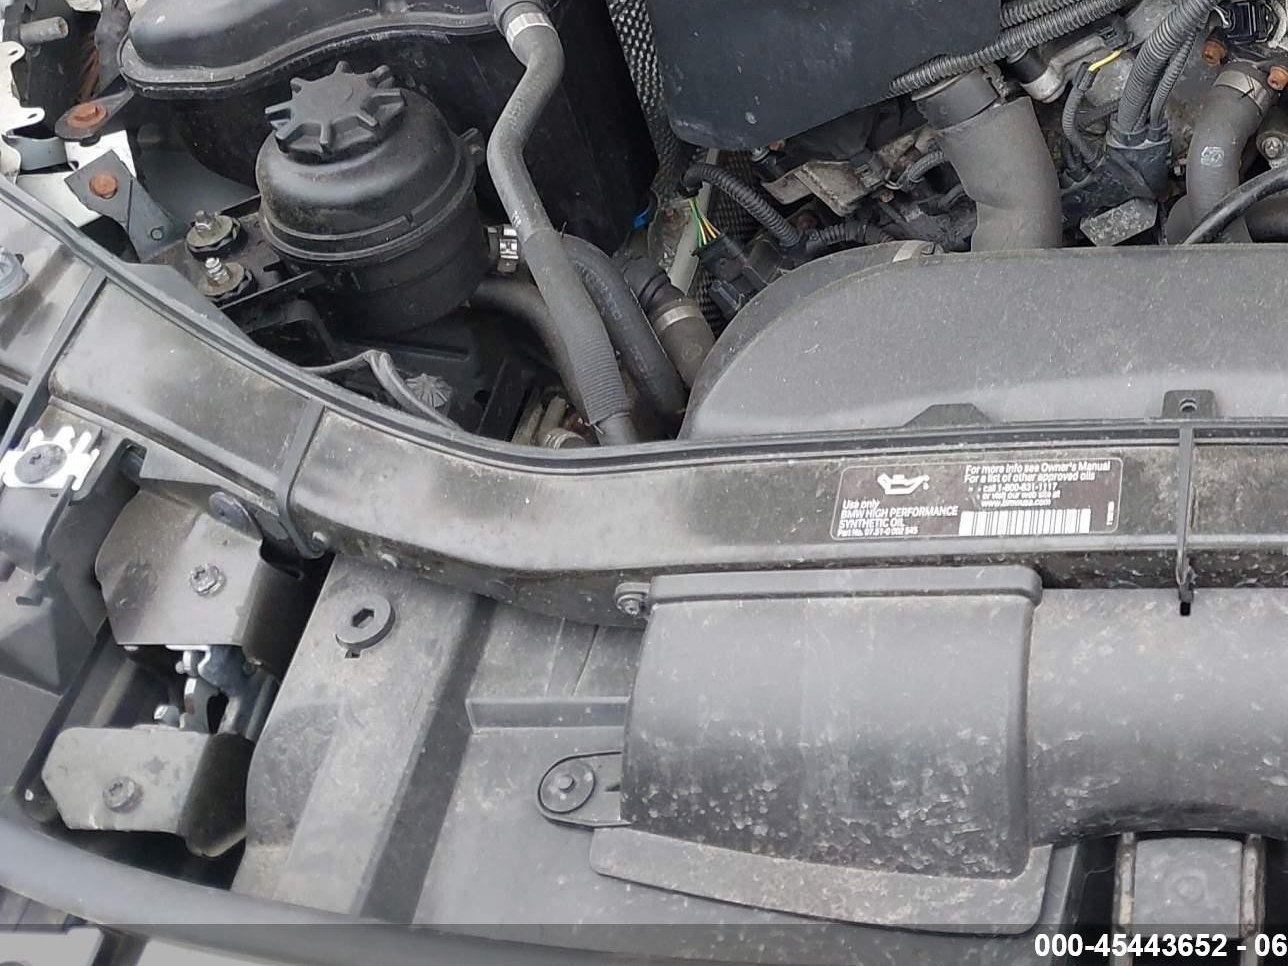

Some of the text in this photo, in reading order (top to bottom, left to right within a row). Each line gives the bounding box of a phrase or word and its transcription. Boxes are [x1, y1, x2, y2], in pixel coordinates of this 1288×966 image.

[965, 464, 981, 474] For
[981, 465, 1005, 474] more
[1024, 464, 1039, 473] see
[1040, 462, 1077, 472] Owner's
[1078, 461, 1110, 471] Manual
[964, 474, 979, 483] For
[987, 474, 1001, 483] list
[1002, 473, 1012, 483] of
[1012, 473, 1036, 482] other
[1037, 471, 1079, 483] approved
[1080, 471, 1095, 481] oils
[842, 498, 880, 510] Use only
[840, 505, 959, 519] BMW HIGH PERFORMANCE
[839, 518, 905, 530] SYNTHETIC OIL
